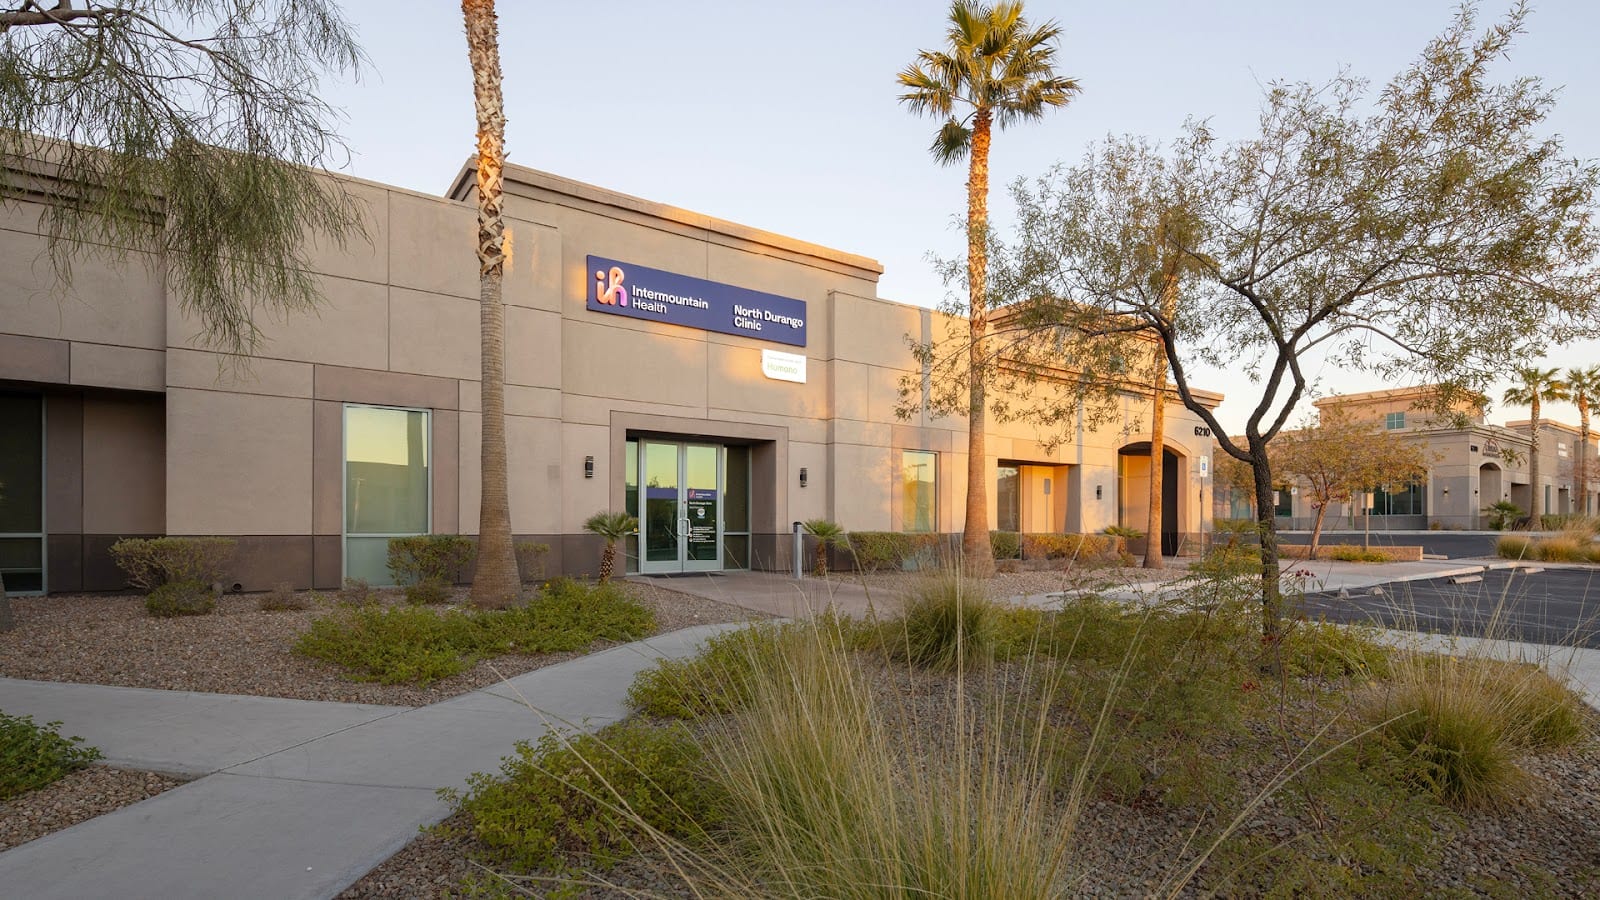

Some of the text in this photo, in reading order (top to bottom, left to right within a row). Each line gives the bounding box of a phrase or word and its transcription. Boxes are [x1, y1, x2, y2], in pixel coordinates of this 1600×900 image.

[632, 285, 709, 309] Intermountain
[632, 298, 667, 314] Health
[734, 304, 804, 329] North Durango
[734, 316, 762, 331] Clinic
[1194, 426, 1211, 437] 6210
